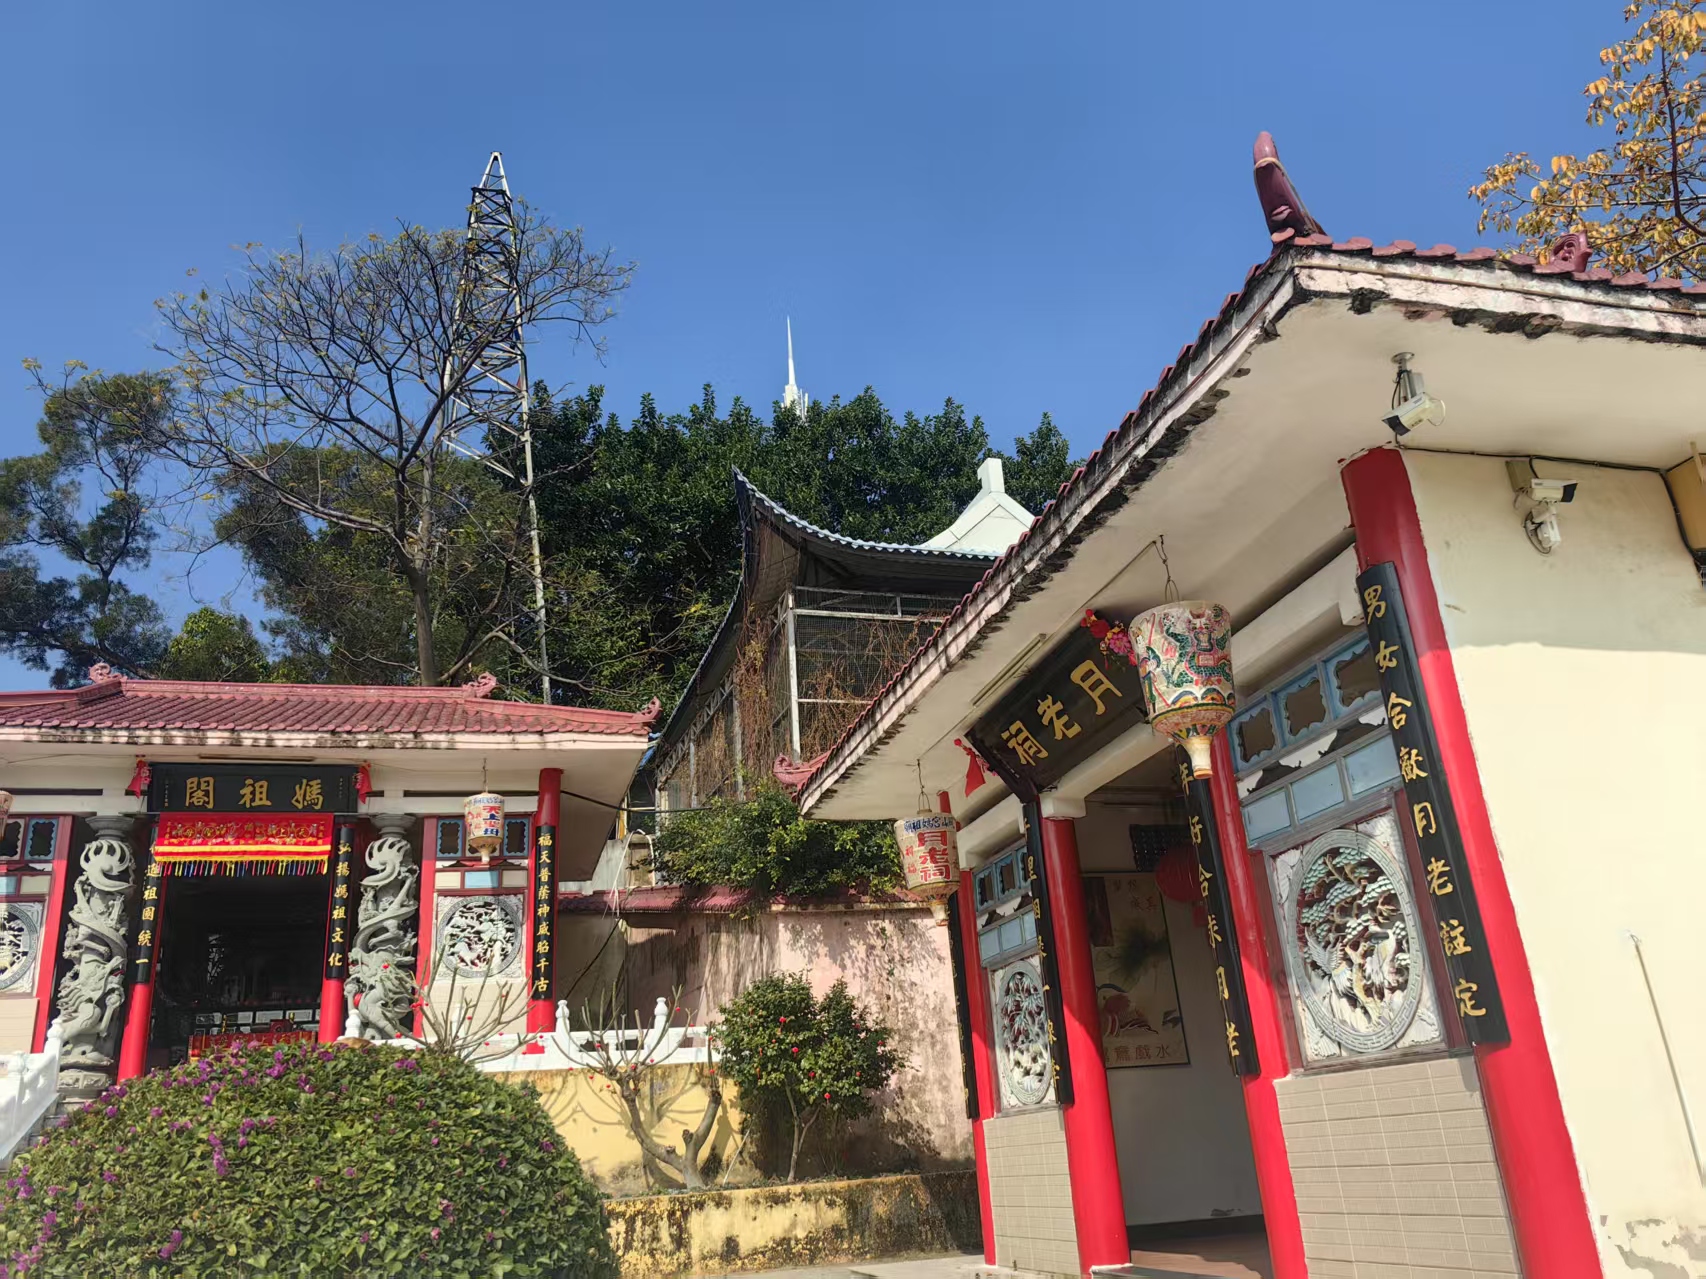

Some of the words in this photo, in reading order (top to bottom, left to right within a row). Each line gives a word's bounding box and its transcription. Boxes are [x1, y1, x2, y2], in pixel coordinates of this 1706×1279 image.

[1001, 659, 1123, 767] 月老祠
[185, 776, 325, 810] 媽祖閣
[917, 830, 951, 882] 月老祠
[328, 840, 352, 967] 弘揚媽祖文化
